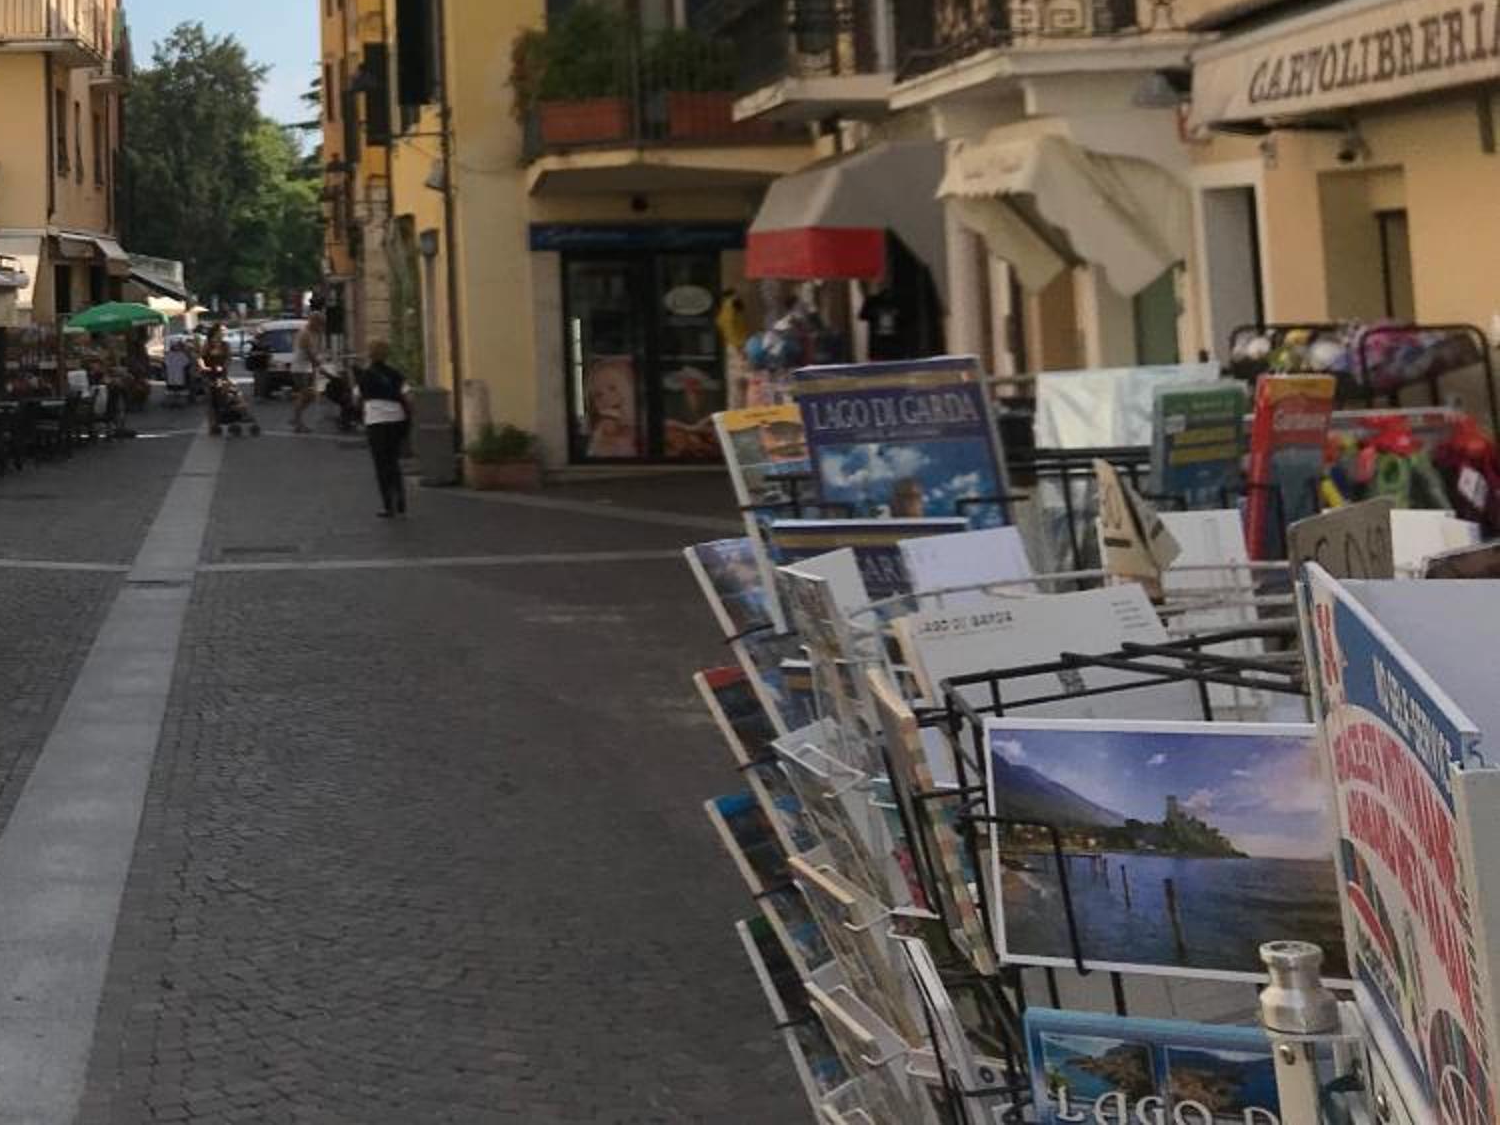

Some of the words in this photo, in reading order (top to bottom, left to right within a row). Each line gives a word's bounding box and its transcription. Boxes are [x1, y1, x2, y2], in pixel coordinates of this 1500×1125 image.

[811, 401, 870, 431] LAGO
[870, 395, 897, 428] DI
[900, 392, 980, 425] GARDA
